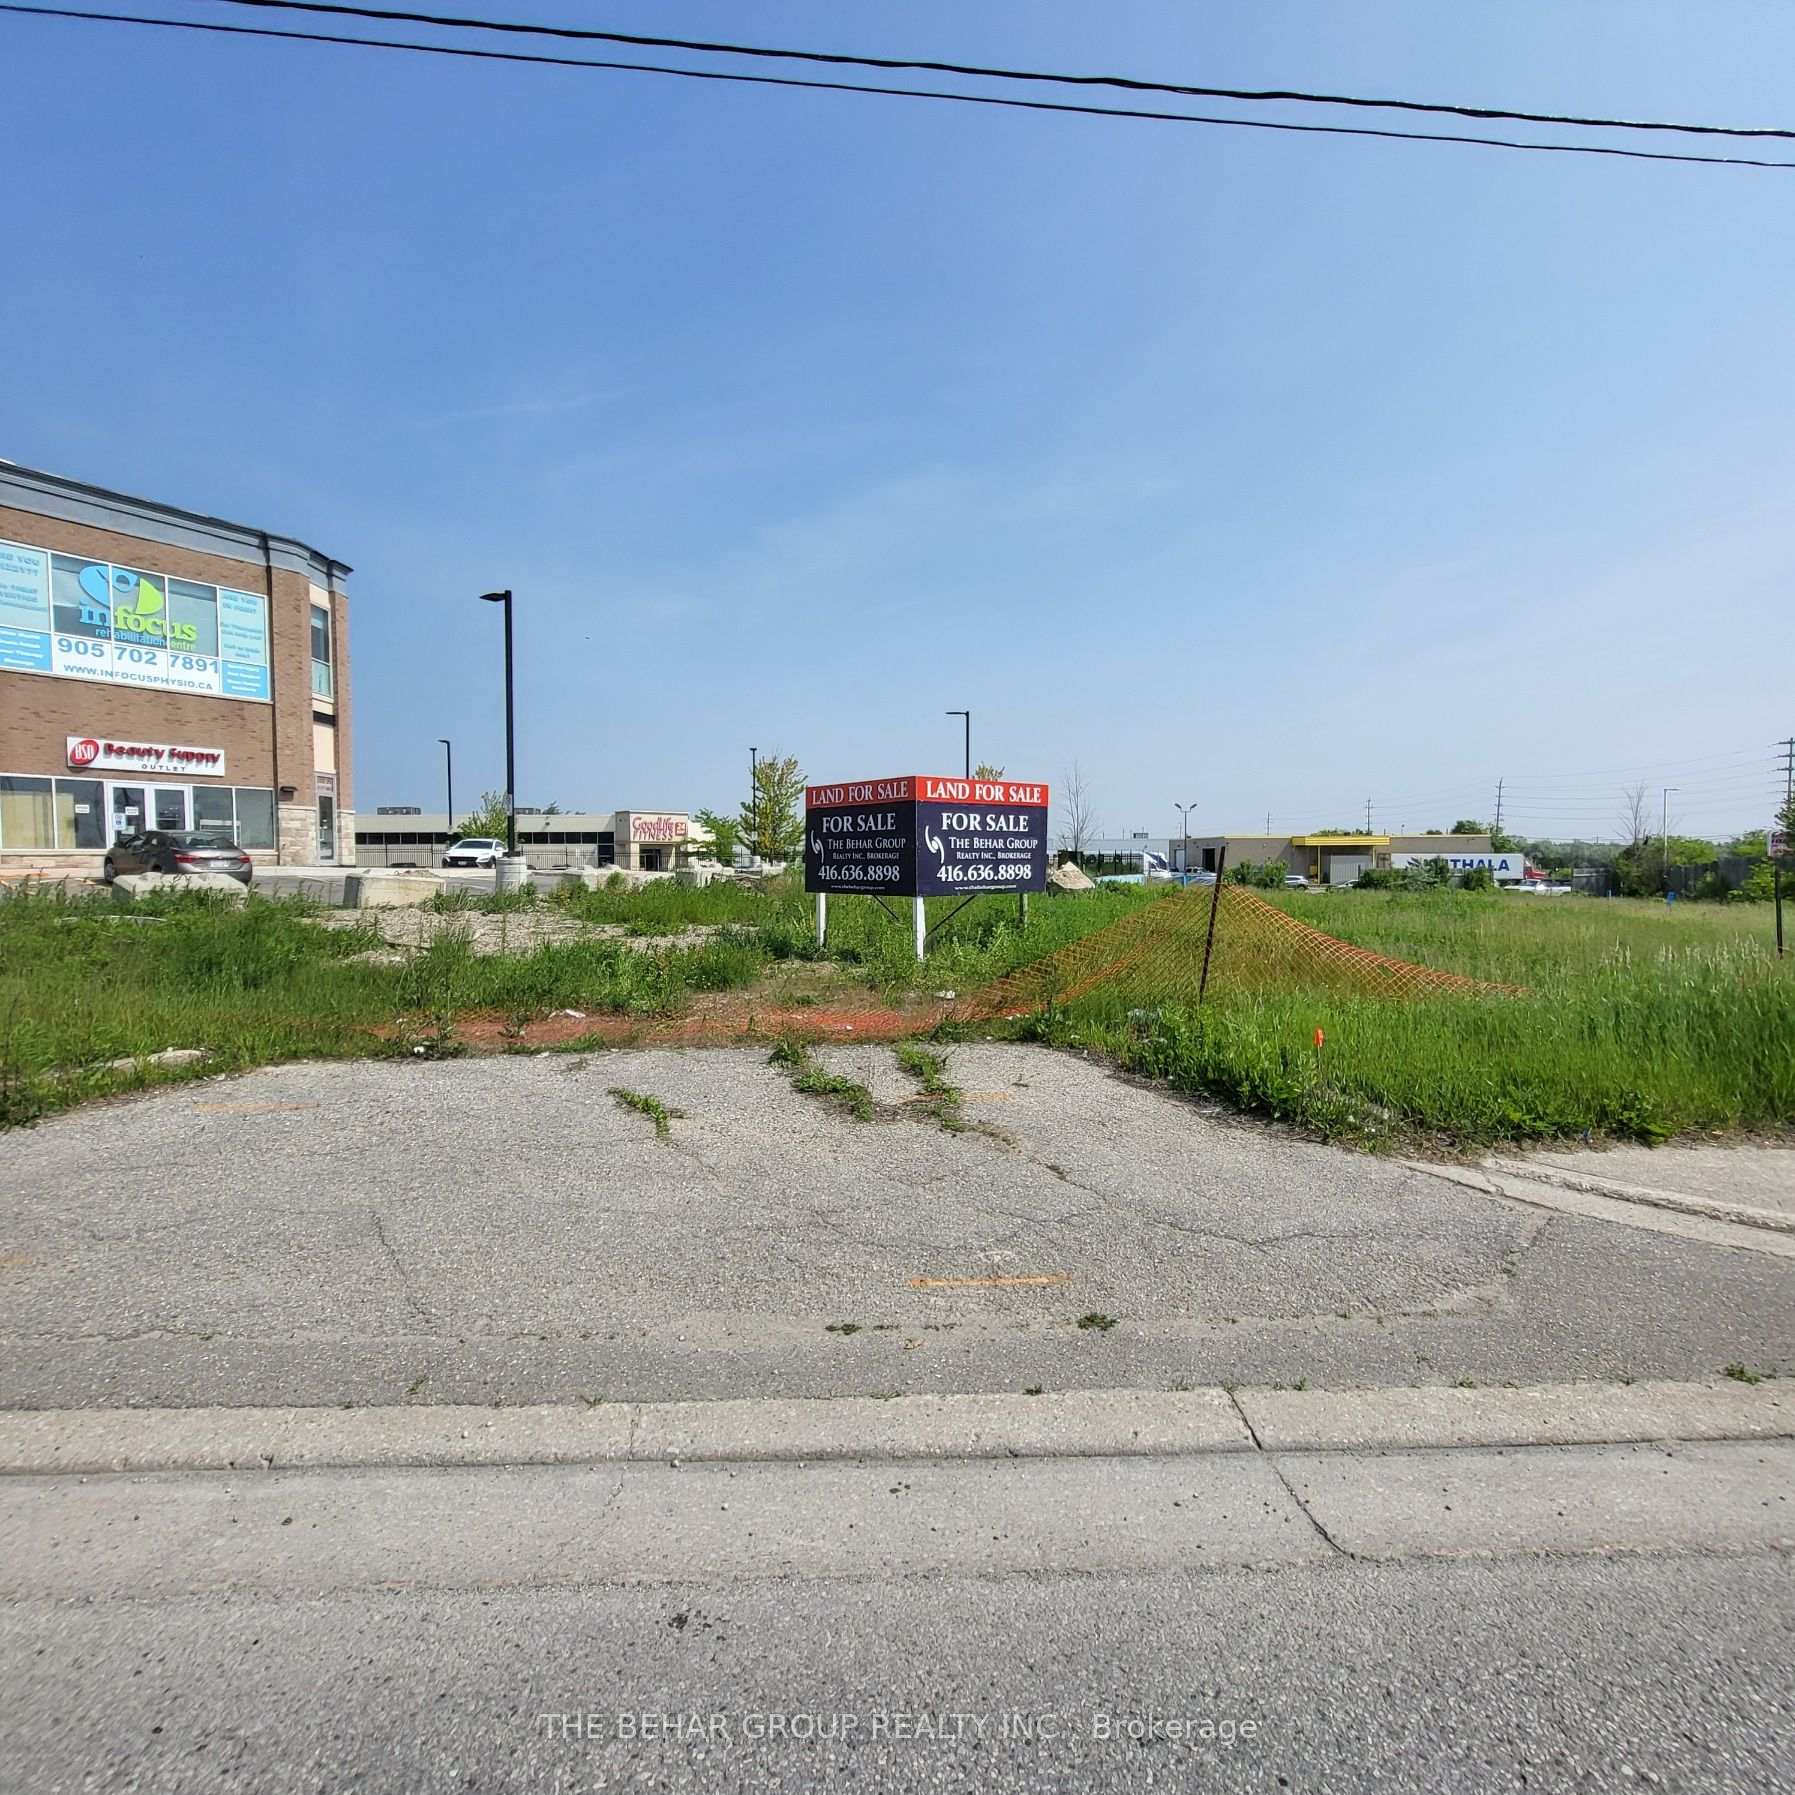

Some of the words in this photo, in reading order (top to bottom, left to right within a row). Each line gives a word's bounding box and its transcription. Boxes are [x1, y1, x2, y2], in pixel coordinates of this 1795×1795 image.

[57, 637, 105, 658] 905
[114, 646, 158, 665] 702
[169, 654, 219, 674] 7891
[63, 664, 213, 691] WWW.INFOCUSPHYSIO.CA
[103, 742, 165, 762] Beauty
[168, 747, 221, 766] Supply
[141, 763, 186, 772] OUTLET
[812, 787, 845, 805] LAND
[848, 784, 874, 802] FOR
[877, 781, 909, 800] SALE
[926, 780, 970, 799] LAND
[975, 783, 1005, 801] FOR
[1009, 785, 1041, 803] SALE
[822, 815, 854, 833] FOR
[857, 812, 896, 832] SALE
[941, 812, 982, 831] FOR
[986, 813, 1029, 832] SALE
[633, 829, 673, 840] FITNESS
[828, 838, 844, 850] THE
[846, 838, 873, 849] BEHAR
[875, 837, 906, 849] GROUP
[949, 836, 970, 849] THE
[973, 837, 1004, 849] BEHAR
[1006, 837, 1038, 849] GROUP
[832, 852, 851, 860] REALTY
[866, 852, 899, 860] BROKERAGE
[956, 851, 980, 860] REALTY
[997, 851, 1032, 860] BROKERAGE
[818, 864, 900, 882] 416.636.8898
[936, 864, 1032, 882] 416.636.8898
